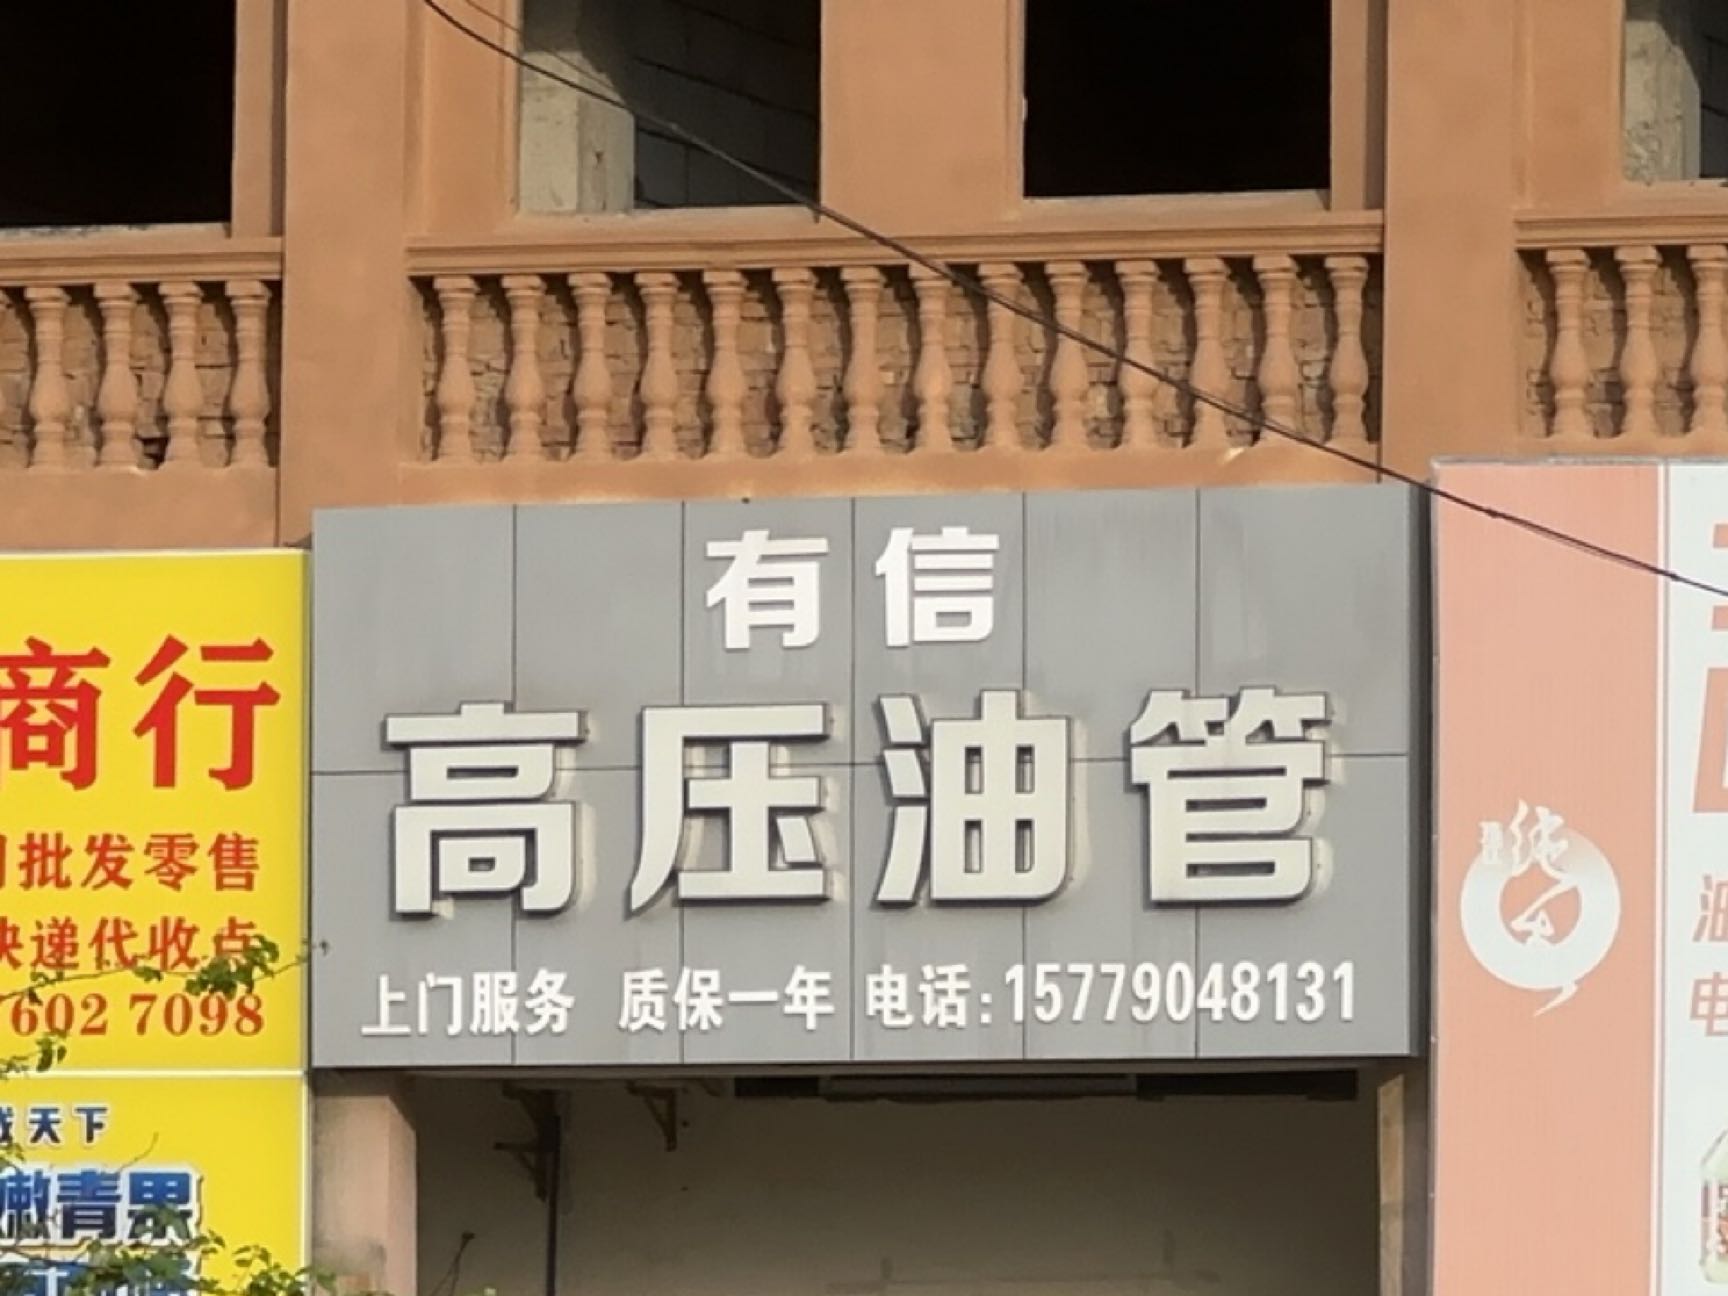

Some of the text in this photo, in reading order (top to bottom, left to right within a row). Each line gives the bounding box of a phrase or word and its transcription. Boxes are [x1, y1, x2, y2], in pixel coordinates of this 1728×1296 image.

[705, 525, 1000, 651] 有信
[0, 634, 281, 791] 商行
[0, 832, 260, 892] 批发零售
[385, 688, 1331, 916] 高压油管
[361, 972, 577, 1038] 上门服务
[617, 964, 836, 1031] 质保一年
